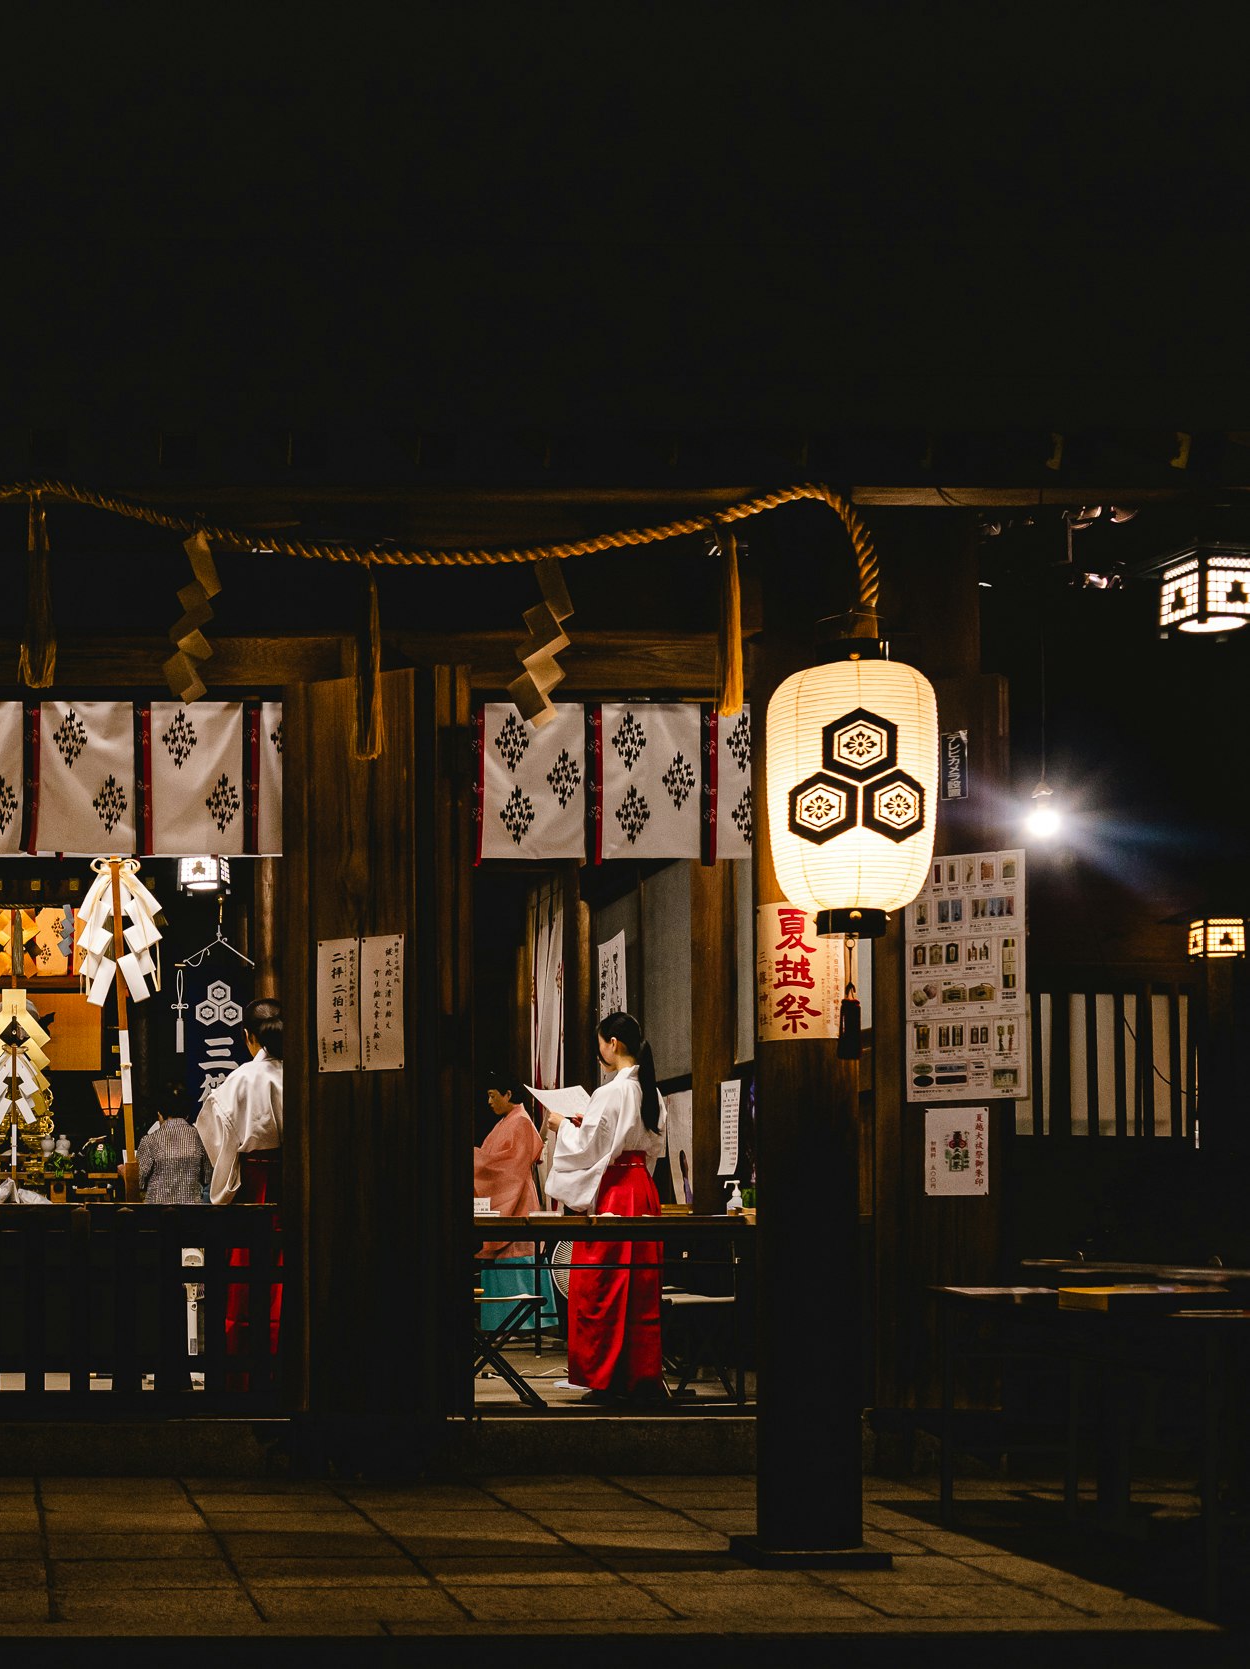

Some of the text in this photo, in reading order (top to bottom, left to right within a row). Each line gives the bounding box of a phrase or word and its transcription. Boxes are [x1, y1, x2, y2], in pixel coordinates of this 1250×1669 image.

[331, 952, 347, 1054] 二拝二拍手一拝
[773, 909, 822, 1034] 夏越祭
[975, 1113, 984, 1187] 夏越大祓祭御朱印
